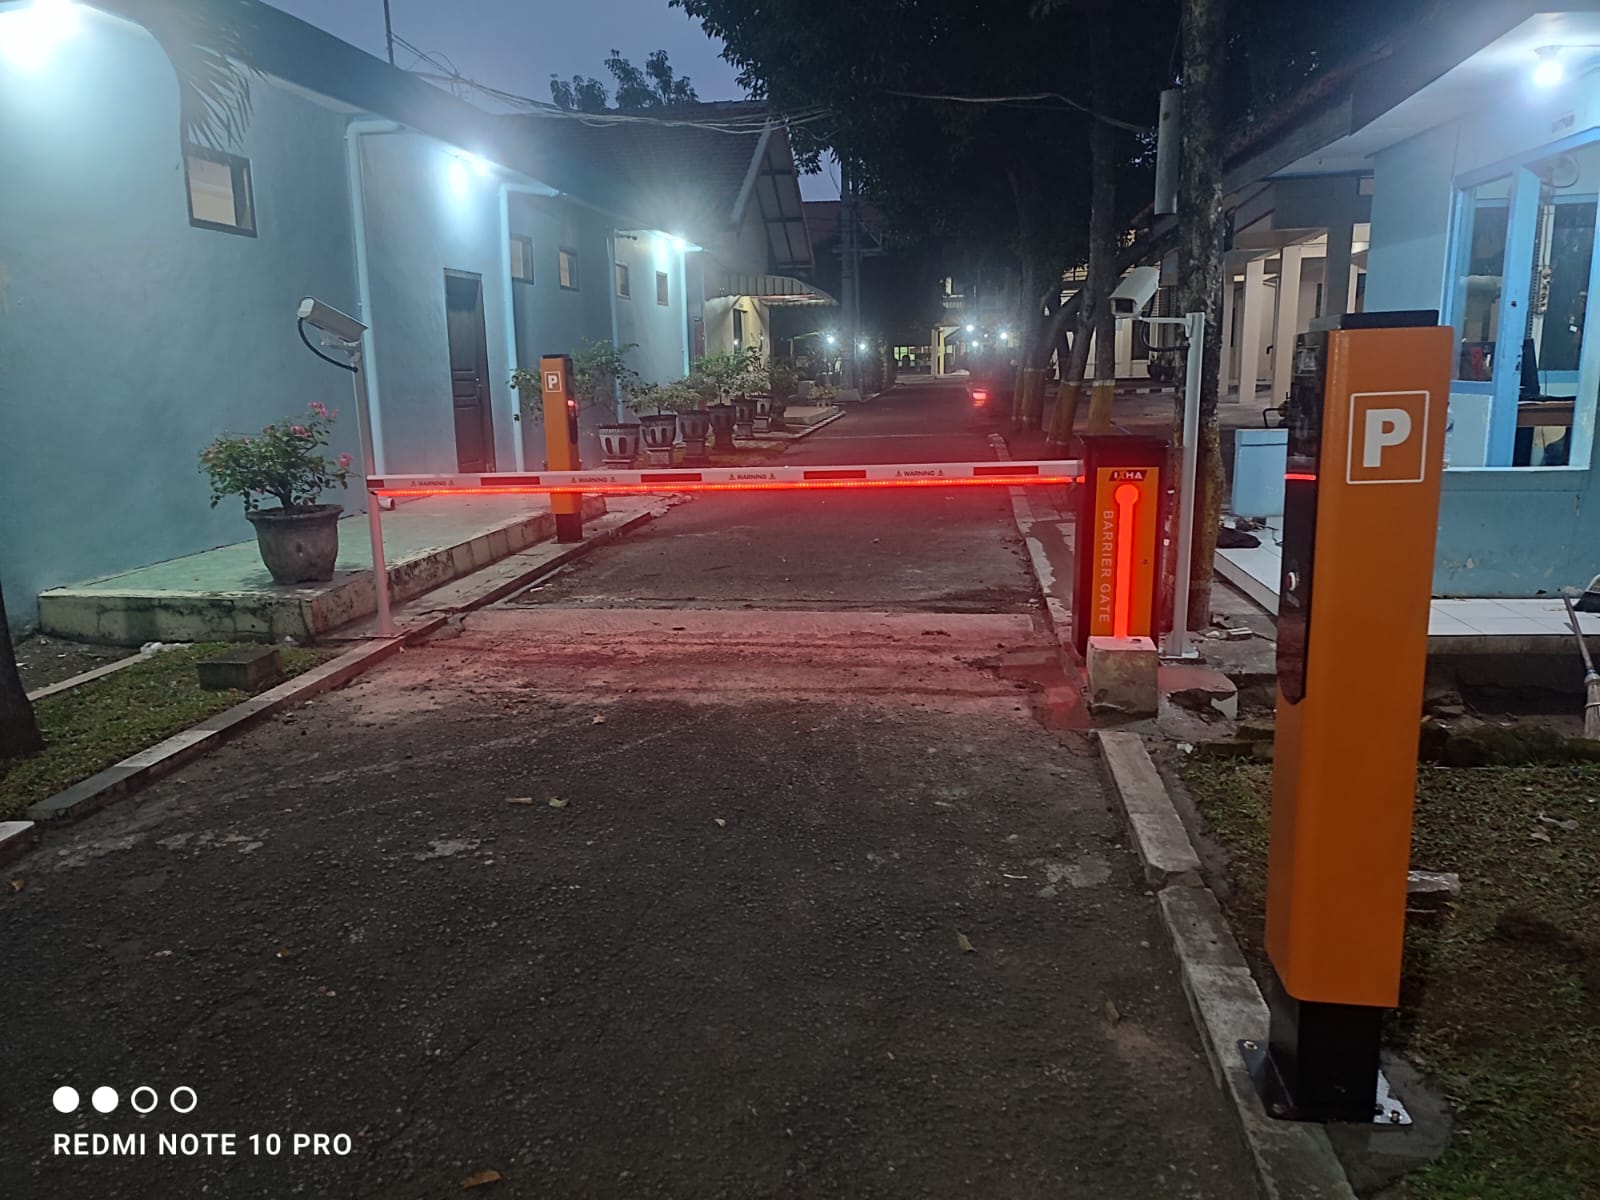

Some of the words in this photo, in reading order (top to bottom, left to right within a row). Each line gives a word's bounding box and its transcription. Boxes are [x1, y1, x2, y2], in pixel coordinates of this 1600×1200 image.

[547, 374, 558, 389] P
[1362, 408, 1412, 468] P
[1101, 510, 1115, 577] BARRIER
[1098, 583, 1112, 623] GATE
